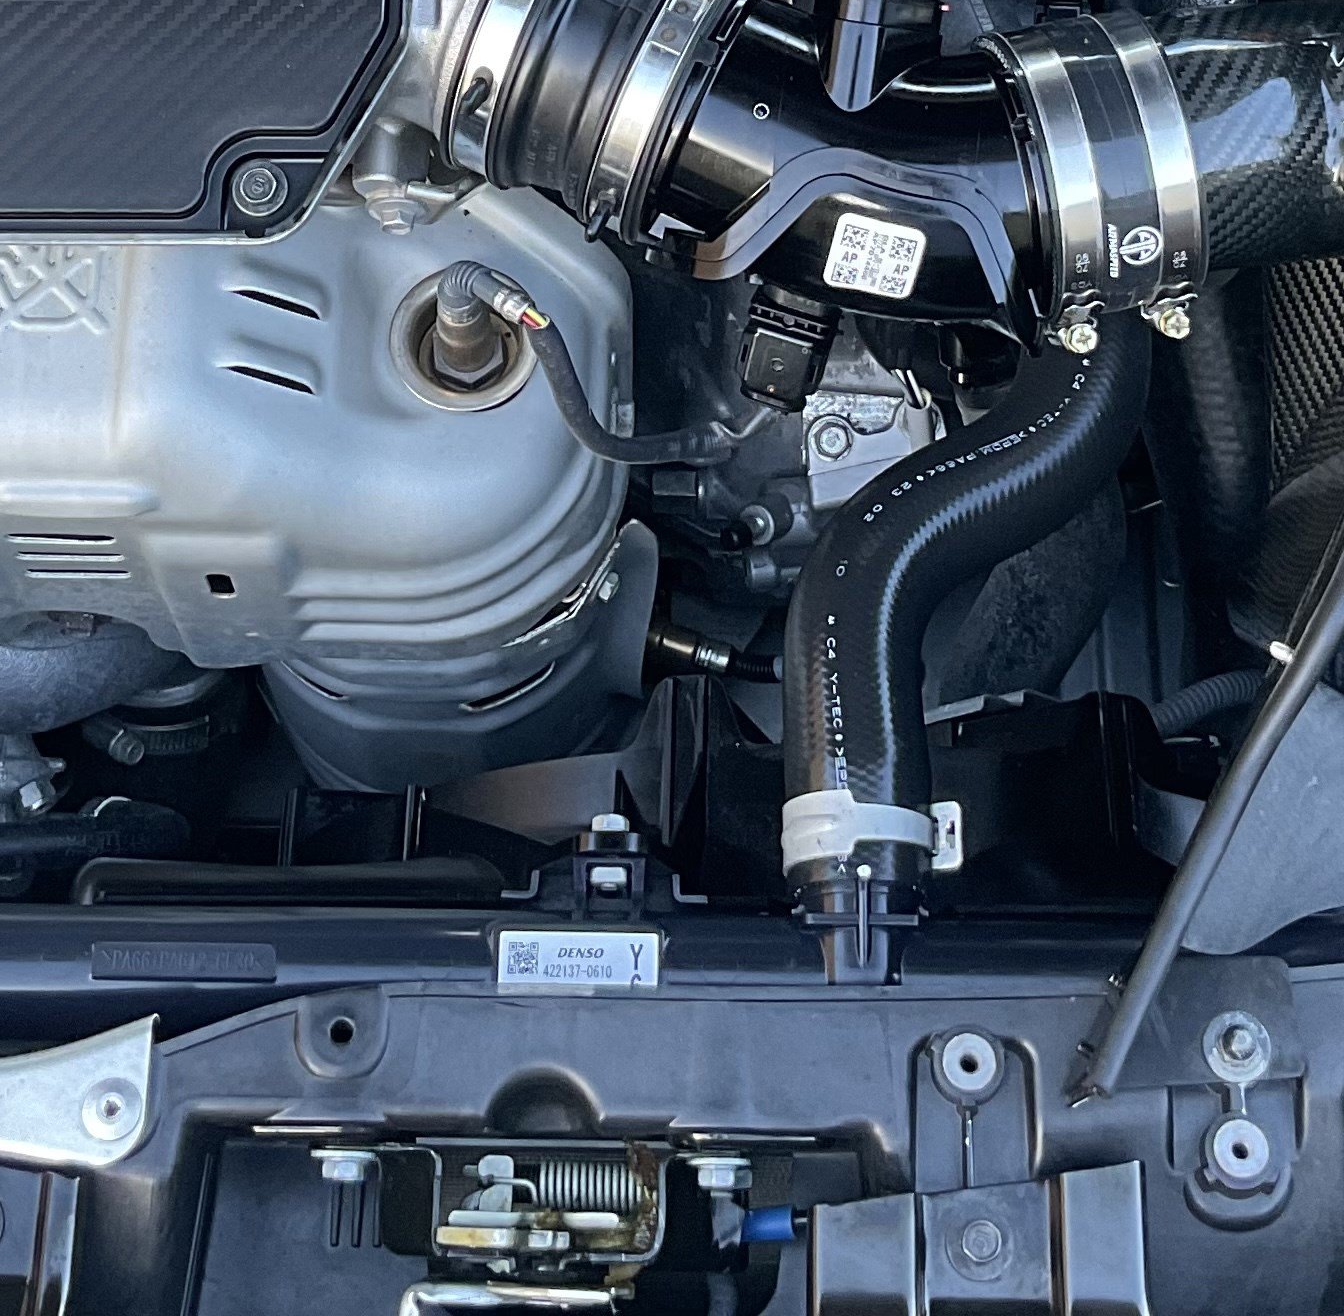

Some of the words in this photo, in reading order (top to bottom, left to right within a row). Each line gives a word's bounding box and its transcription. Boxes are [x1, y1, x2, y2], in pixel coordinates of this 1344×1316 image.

[841, 251, 858, 263] AP
[893, 264, 910, 276] AP
[891, 481, 913, 497] 23
[557, 947, 604, 959] DENSO
[629, 943, 644, 971] Y
[543, 963, 612, 979] 422137-0610
